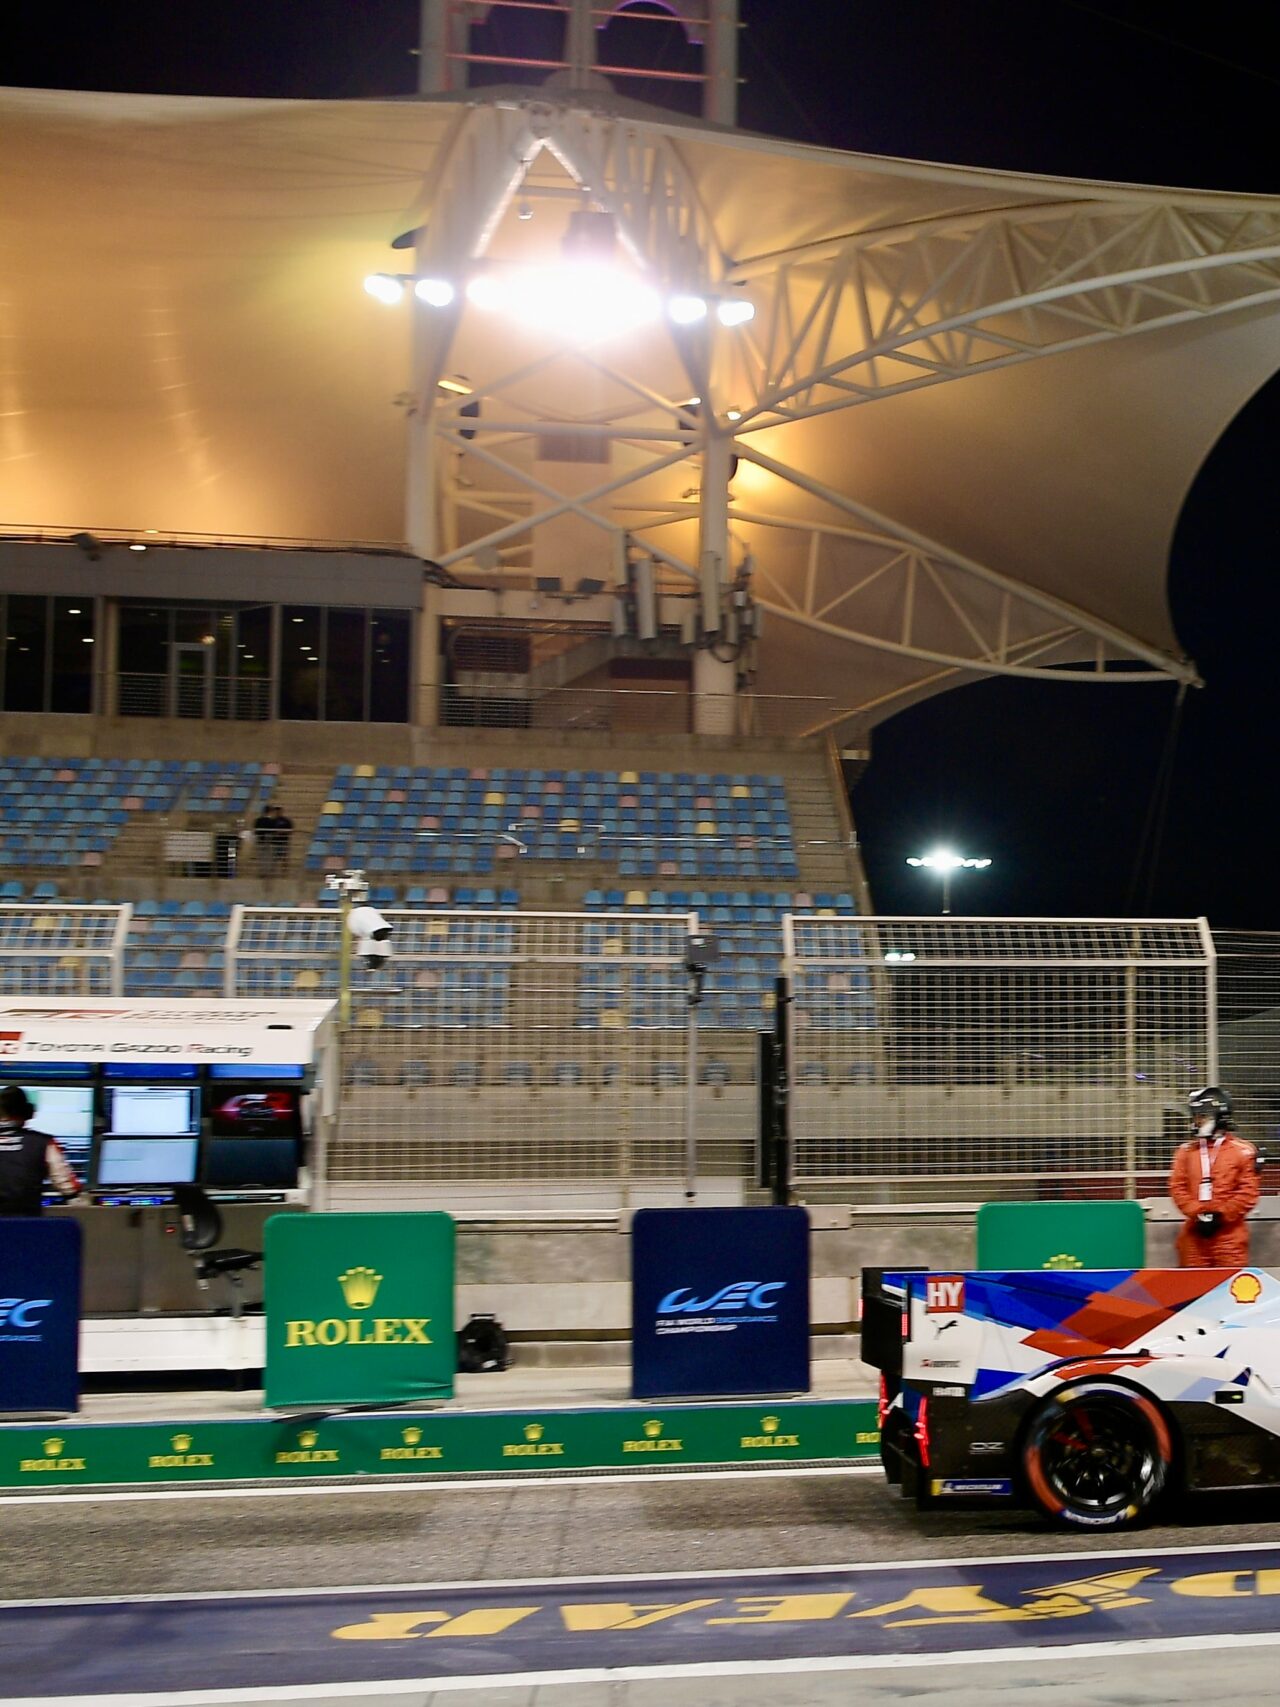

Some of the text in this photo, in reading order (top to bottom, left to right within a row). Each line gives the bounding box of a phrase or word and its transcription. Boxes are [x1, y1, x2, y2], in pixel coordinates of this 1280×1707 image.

[656, 1281, 787, 1314] WEC
[927, 1281, 964, 1307] HY
[284, 1319, 434, 1347] ROLEX
[623, 1439, 683, 1452] ROLEX
[741, 1435, 799, 1448] ROLEX
[380, 1447, 442, 1460] ROLEX
[503, 1443, 564, 1456] ROLEX
[148, 1454, 214, 1468] ROLEX
[276, 1450, 339, 1463] ROLEX
[20, 1458, 86, 1472] ROLEX
